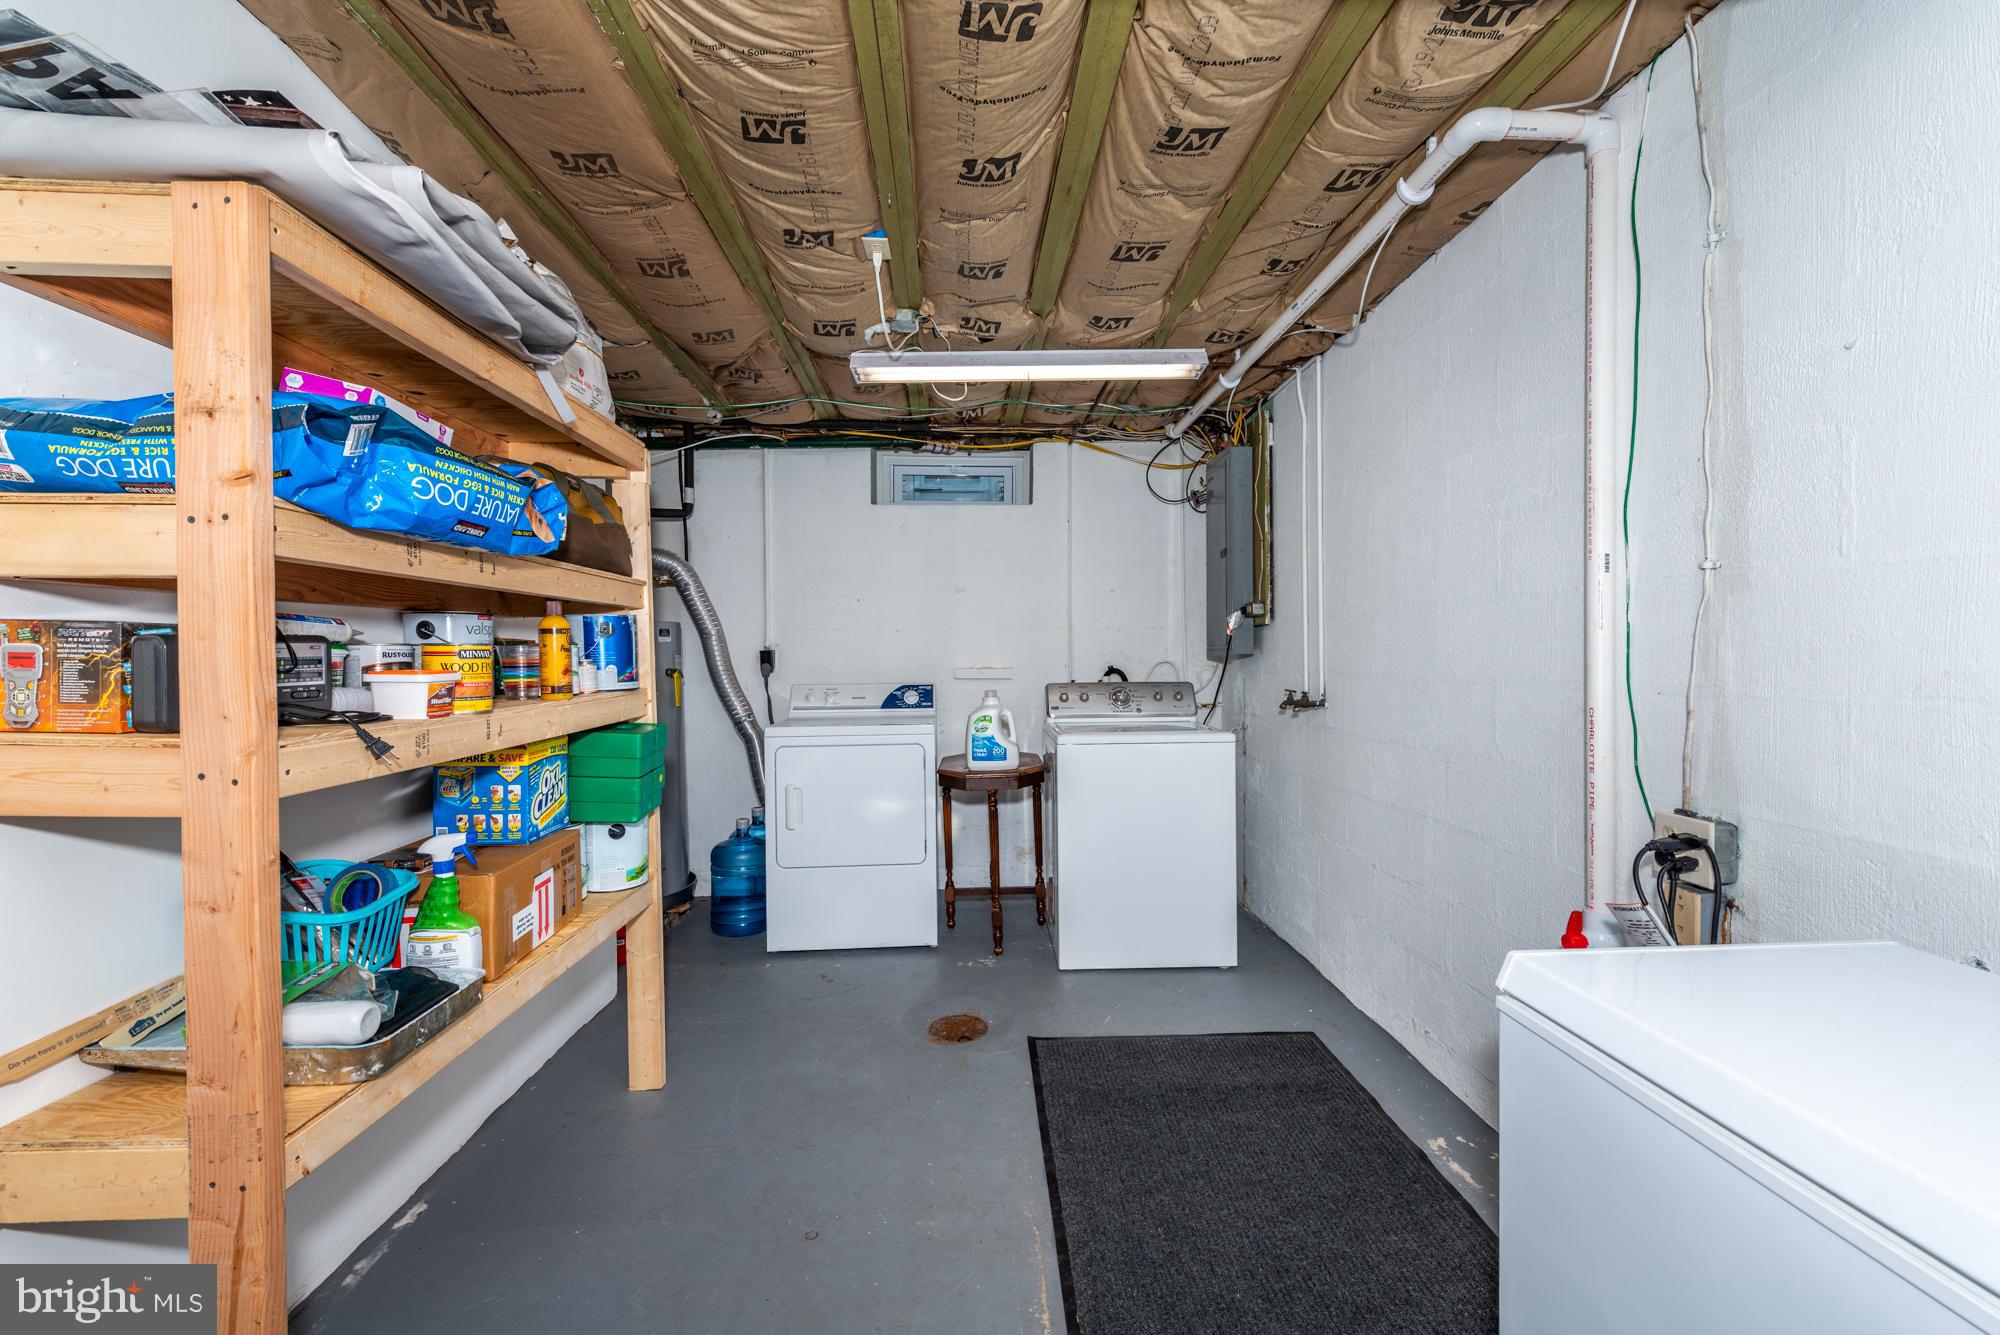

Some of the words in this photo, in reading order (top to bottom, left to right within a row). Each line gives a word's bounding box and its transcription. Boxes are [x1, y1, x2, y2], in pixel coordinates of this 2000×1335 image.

[958, 2, 1043, 42] JM
[1428, 24, 1458, 37] Johns
[1459, 28, 1505, 41] Manville
[1365, 96, 1396, 110] Control
[740, 116, 806, 144] JM
[1156, 126, 1230, 151] JM
[549, 150, 620, 174] JM
[958, 152, 1022, 182] JM
[1109, 244, 1167, 262] JM
[637, 259, 691, 279] JM
[958, 263, 1007, 280] JM
[813, 322, 856, 337] JM
[960, 317, 1001, 335] JM
[1088, 316, 1135, 330] JM
[692, 328, 735, 345] JM
[71, 426, 97, 437] DOGS
[47, 444, 105, 457] FORMULA
[130, 446, 140, 455] &
[144, 438, 167, 446] WITH
[144, 446, 169, 455] RICE
[55, 456, 118, 479] DOG
[406, 461, 460, 486] FORMULA
[434, 459, 473, 476] CHICKEN
[462, 479, 482, 492] EGG
[473, 471, 491, 483] FRESH
[410, 476, 469, 511] DOG
[491, 487, 505, 499] RICE
[506, 482, 521, 492] MADE
[453, 523, 485, 538] KIRKLAND
[440, 662, 480, 673] WOOD
[1588, 707, 1596, 774] CHARLOTTE
[488, 753, 497, 763] &
[498, 753, 525, 763] SAVE
[541, 762, 562, 793] OXI
[533, 774, 567, 821] CLEAN
[1588, 781, 1596, 811] PIPE
[7, 1060, 21, 1071] Do
[21, 1053, 37, 1066] you
[37, 1045, 57, 1057] have
[64, 1034, 75, 1045] all
[74, 1018, 108, 1040] covered?
